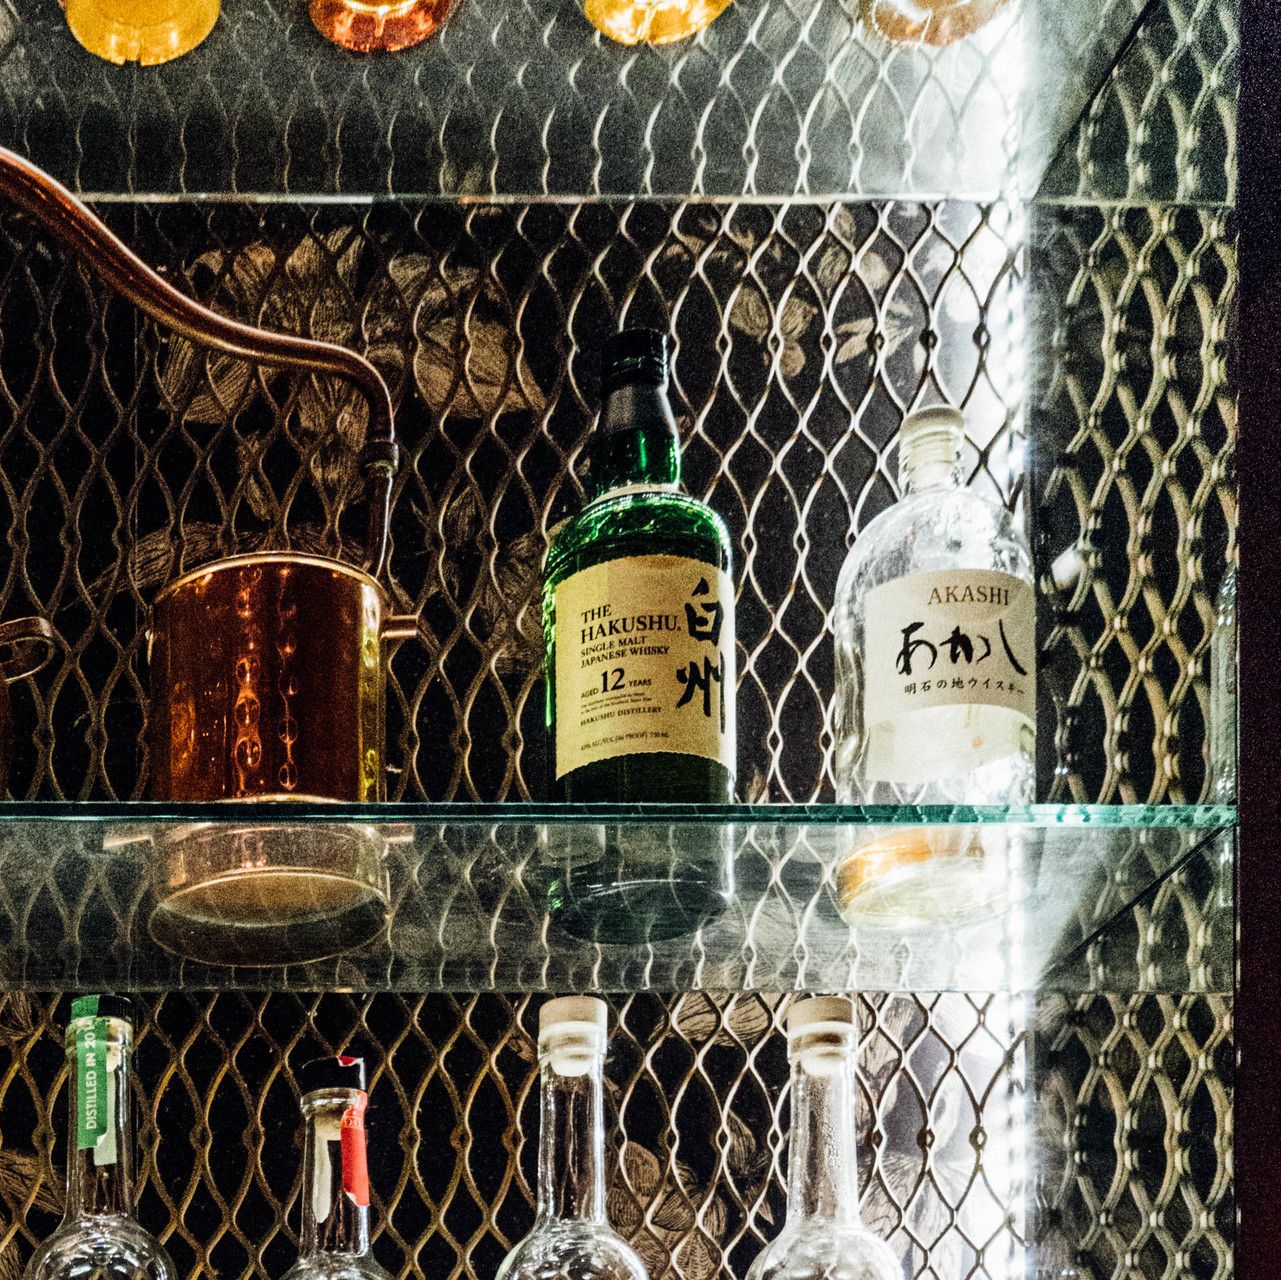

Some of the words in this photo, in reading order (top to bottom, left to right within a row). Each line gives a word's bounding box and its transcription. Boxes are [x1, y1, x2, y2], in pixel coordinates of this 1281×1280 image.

[928, 585, 1009, 606] AKASHI
[581, 604, 612, 624] THE
[581, 641, 615, 657] SINGLE
[619, 636, 647, 648] MALT
[581, 650, 628, 668] JAPANESE
[630, 646, 670, 656] WHISKY
[896, 619, 1027, 676] あかし
[581, 687, 598, 699] AGED
[601, 667, 626, 694] 12
[628, 678, 652, 688] YEARS
[580, 711, 615, 726] HAKUSHU
[618, 706, 662, 717] DISTILLERY
